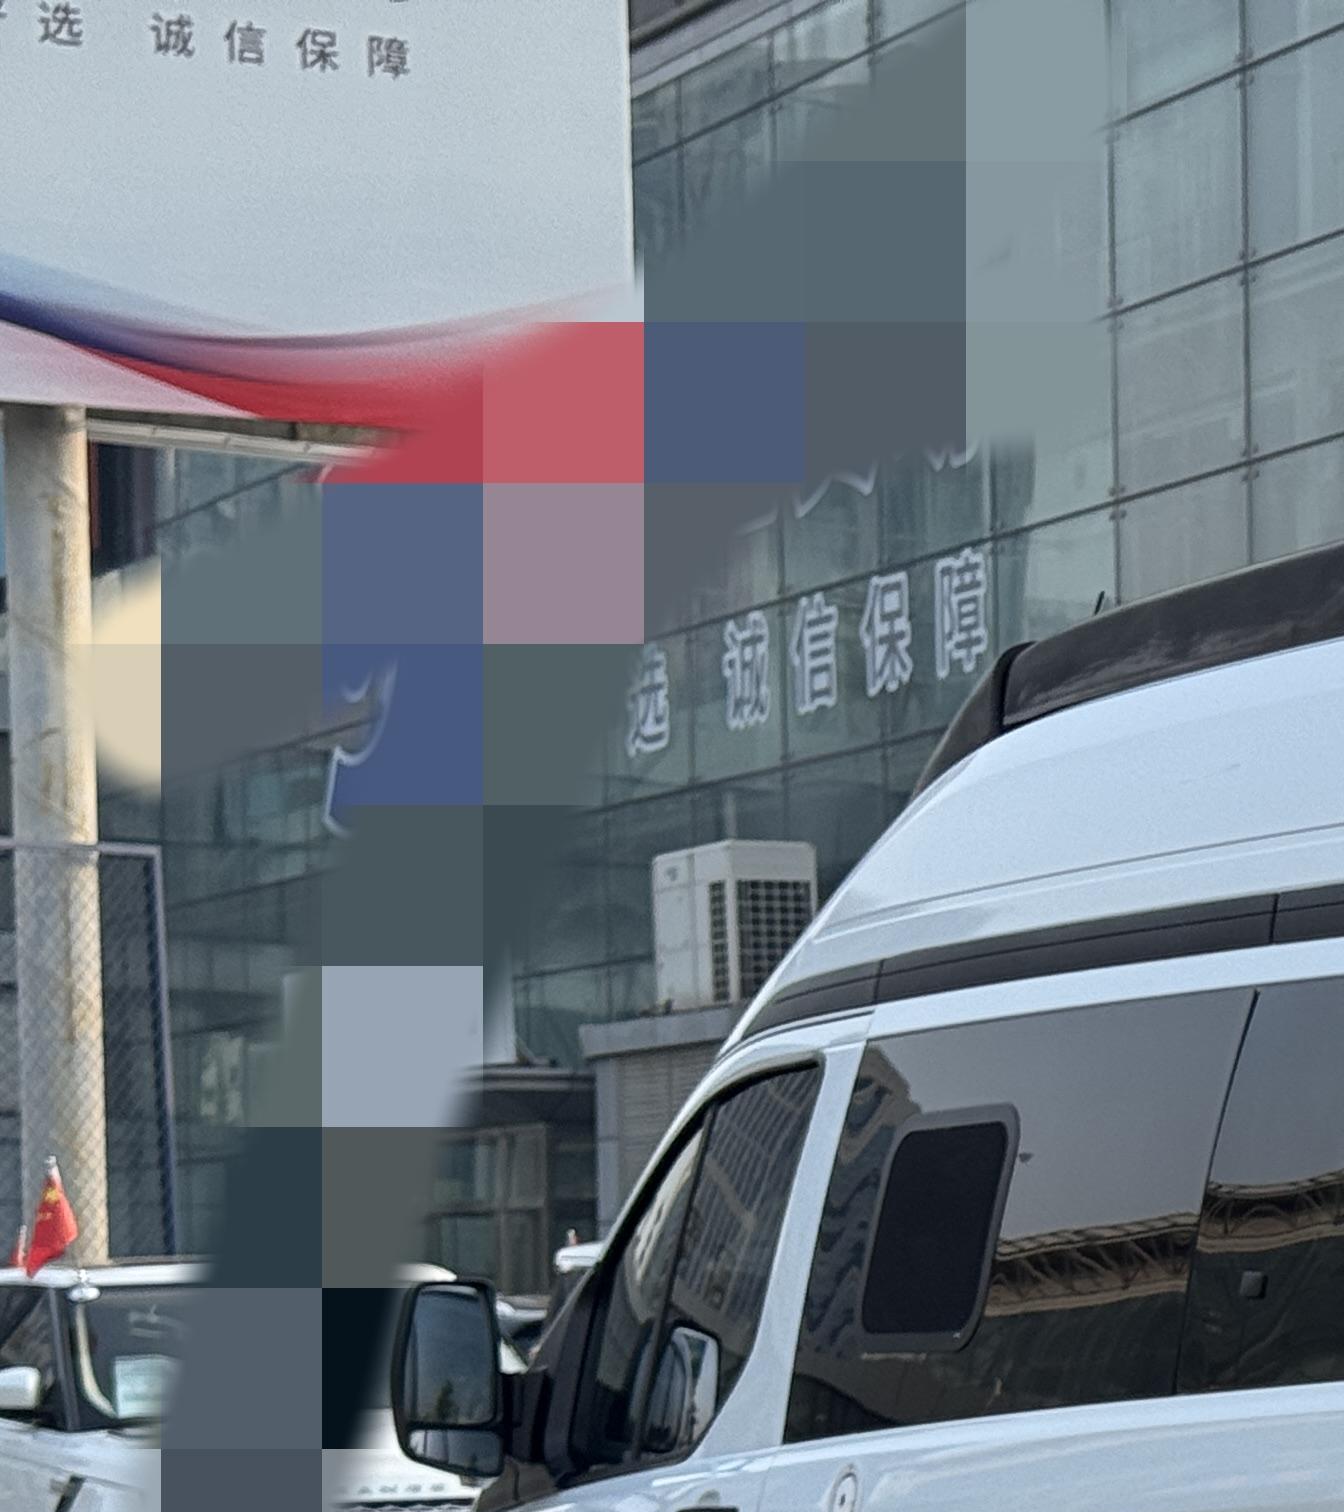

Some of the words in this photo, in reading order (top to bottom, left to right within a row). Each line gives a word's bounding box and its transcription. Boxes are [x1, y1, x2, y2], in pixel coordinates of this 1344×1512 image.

[150, 13, 411, 79] 诚信保障
[722, 546, 989, 730] 诚信保障
